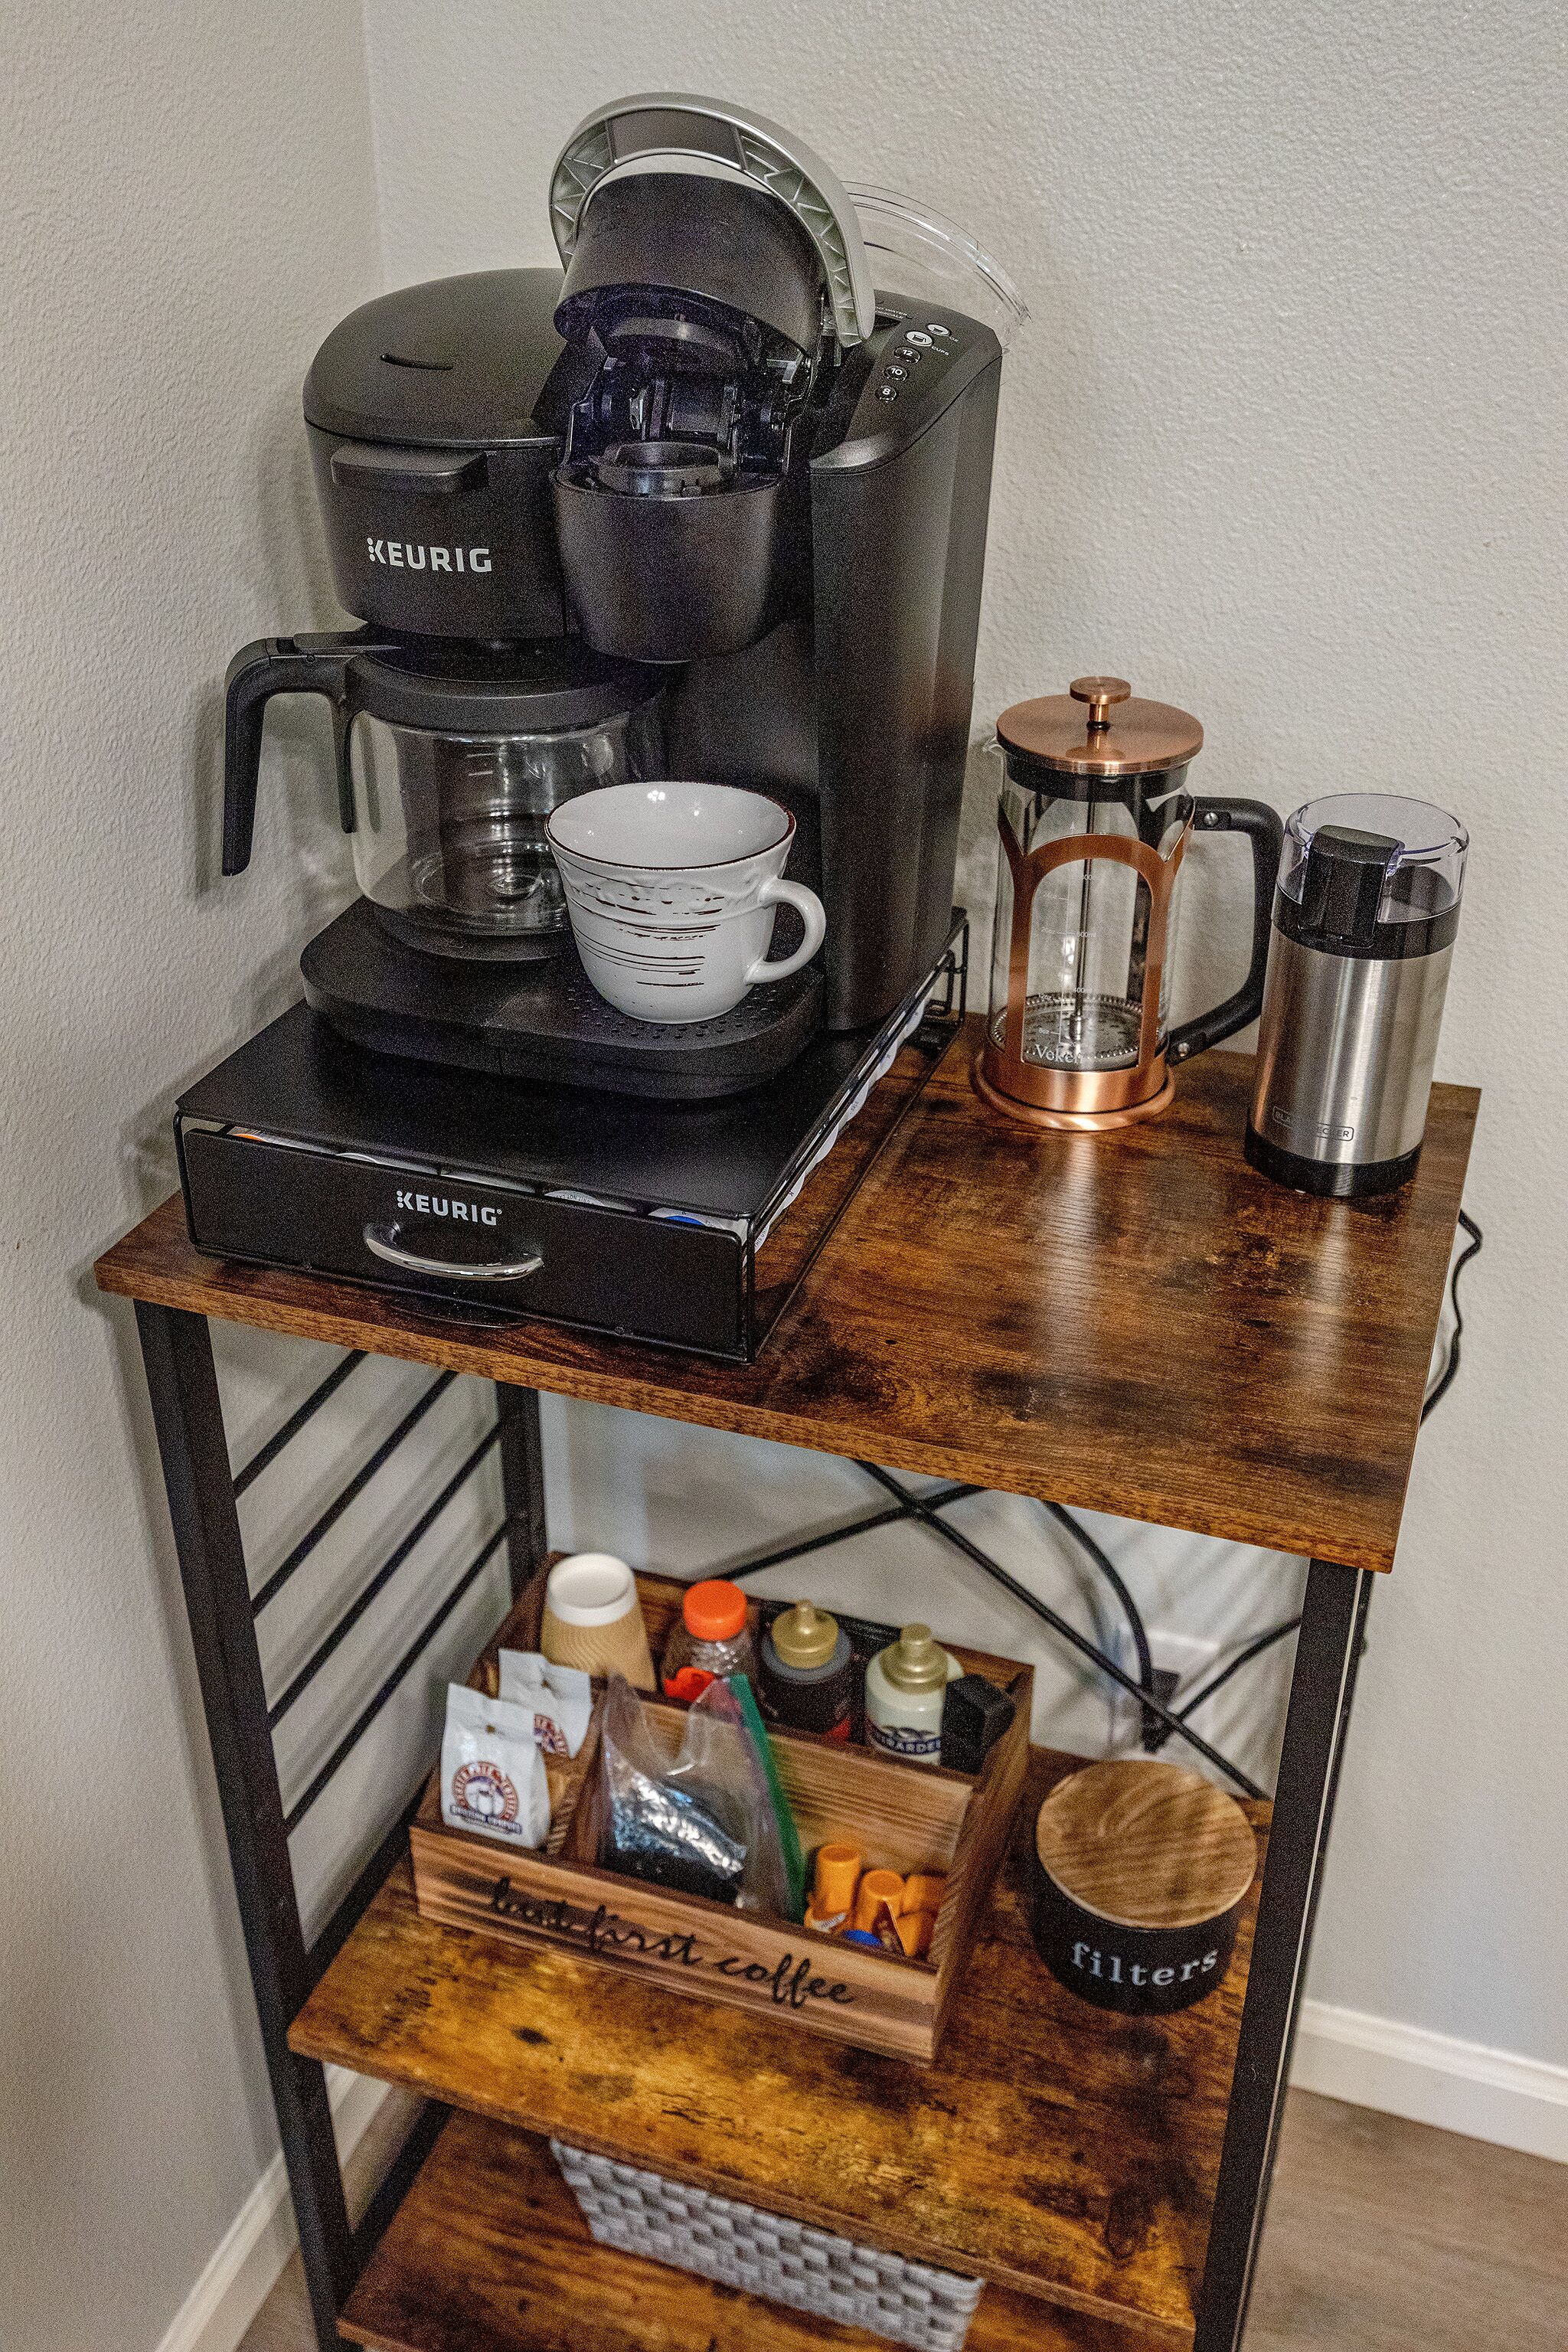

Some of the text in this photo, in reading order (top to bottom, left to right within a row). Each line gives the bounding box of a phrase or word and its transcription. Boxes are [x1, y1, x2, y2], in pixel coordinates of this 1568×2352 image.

[931, 346, 949, 356] CUPS
[367, 537, 492, 573] KEURIG
[588, 1904, 703, 1965] first
[713, 1953, 854, 2010] coffee
[1071, 1941, 1219, 1986] filters
